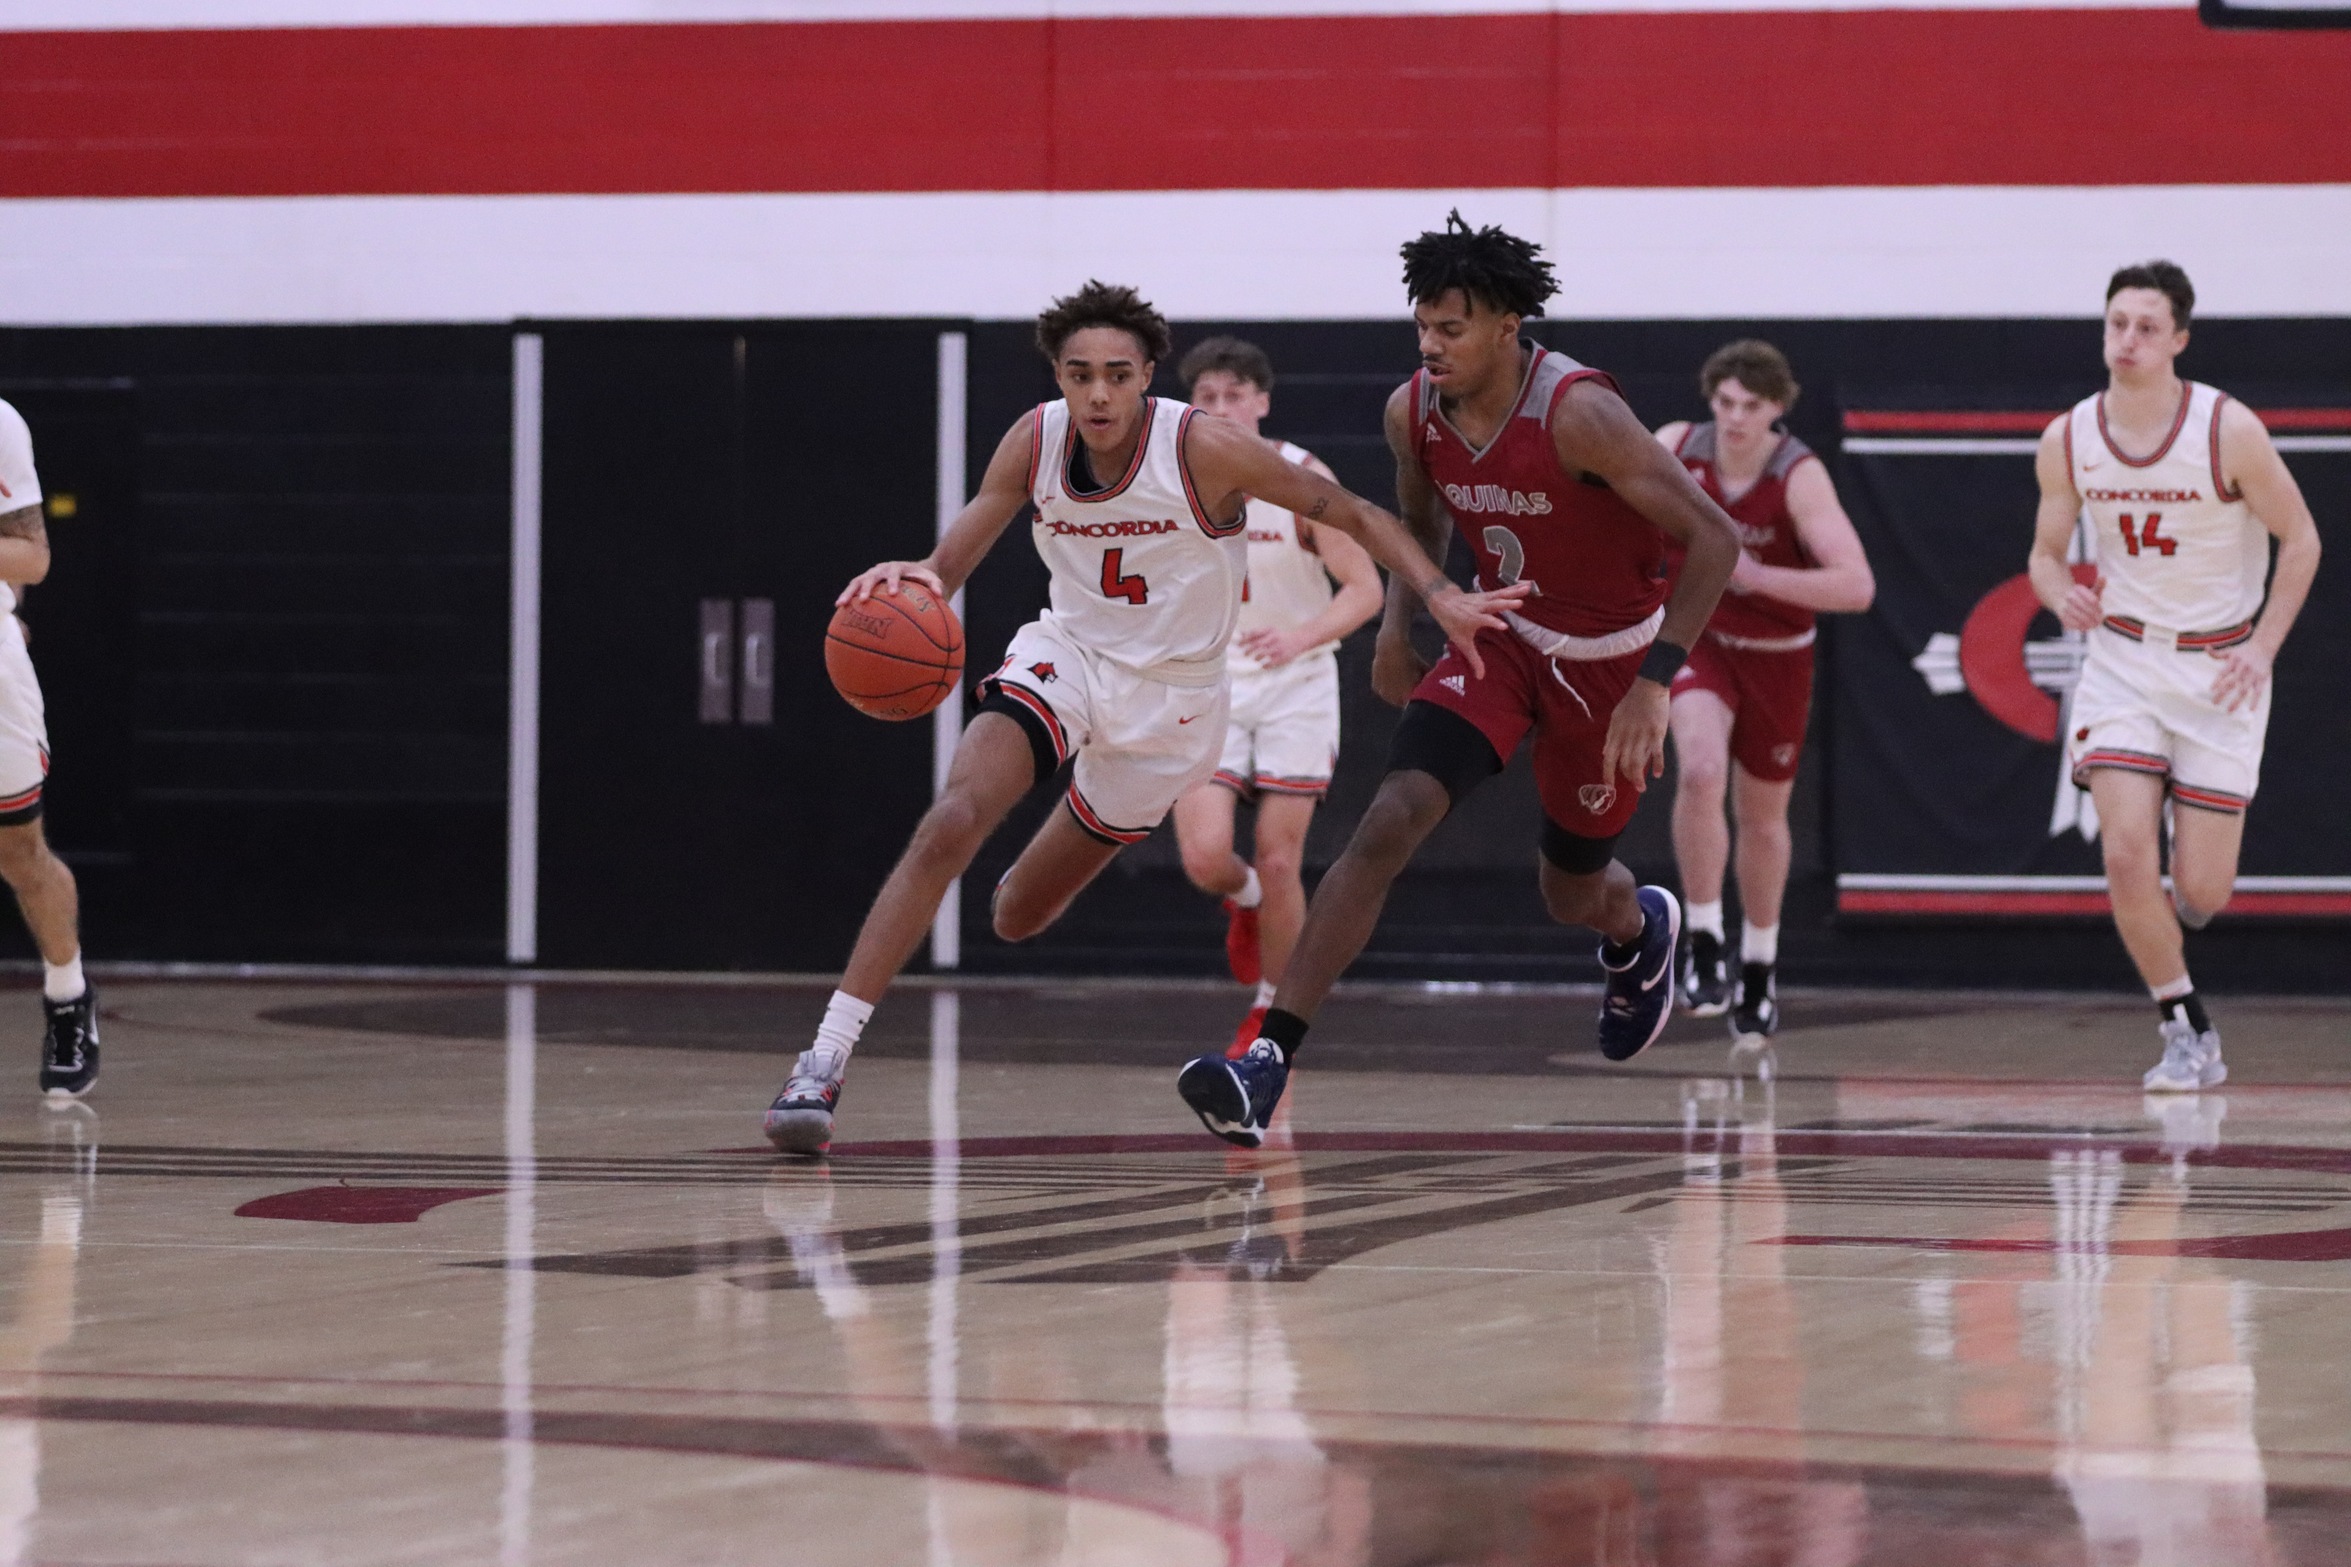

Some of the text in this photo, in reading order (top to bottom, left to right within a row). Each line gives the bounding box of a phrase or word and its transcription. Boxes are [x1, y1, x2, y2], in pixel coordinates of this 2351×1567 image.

[1435, 480, 1553, 516] QUINAS
[2085, 488, 2202, 502] CONCORDIA
[2119, 512, 2178, 556] 14
[1100, 547, 1149, 605] 4
